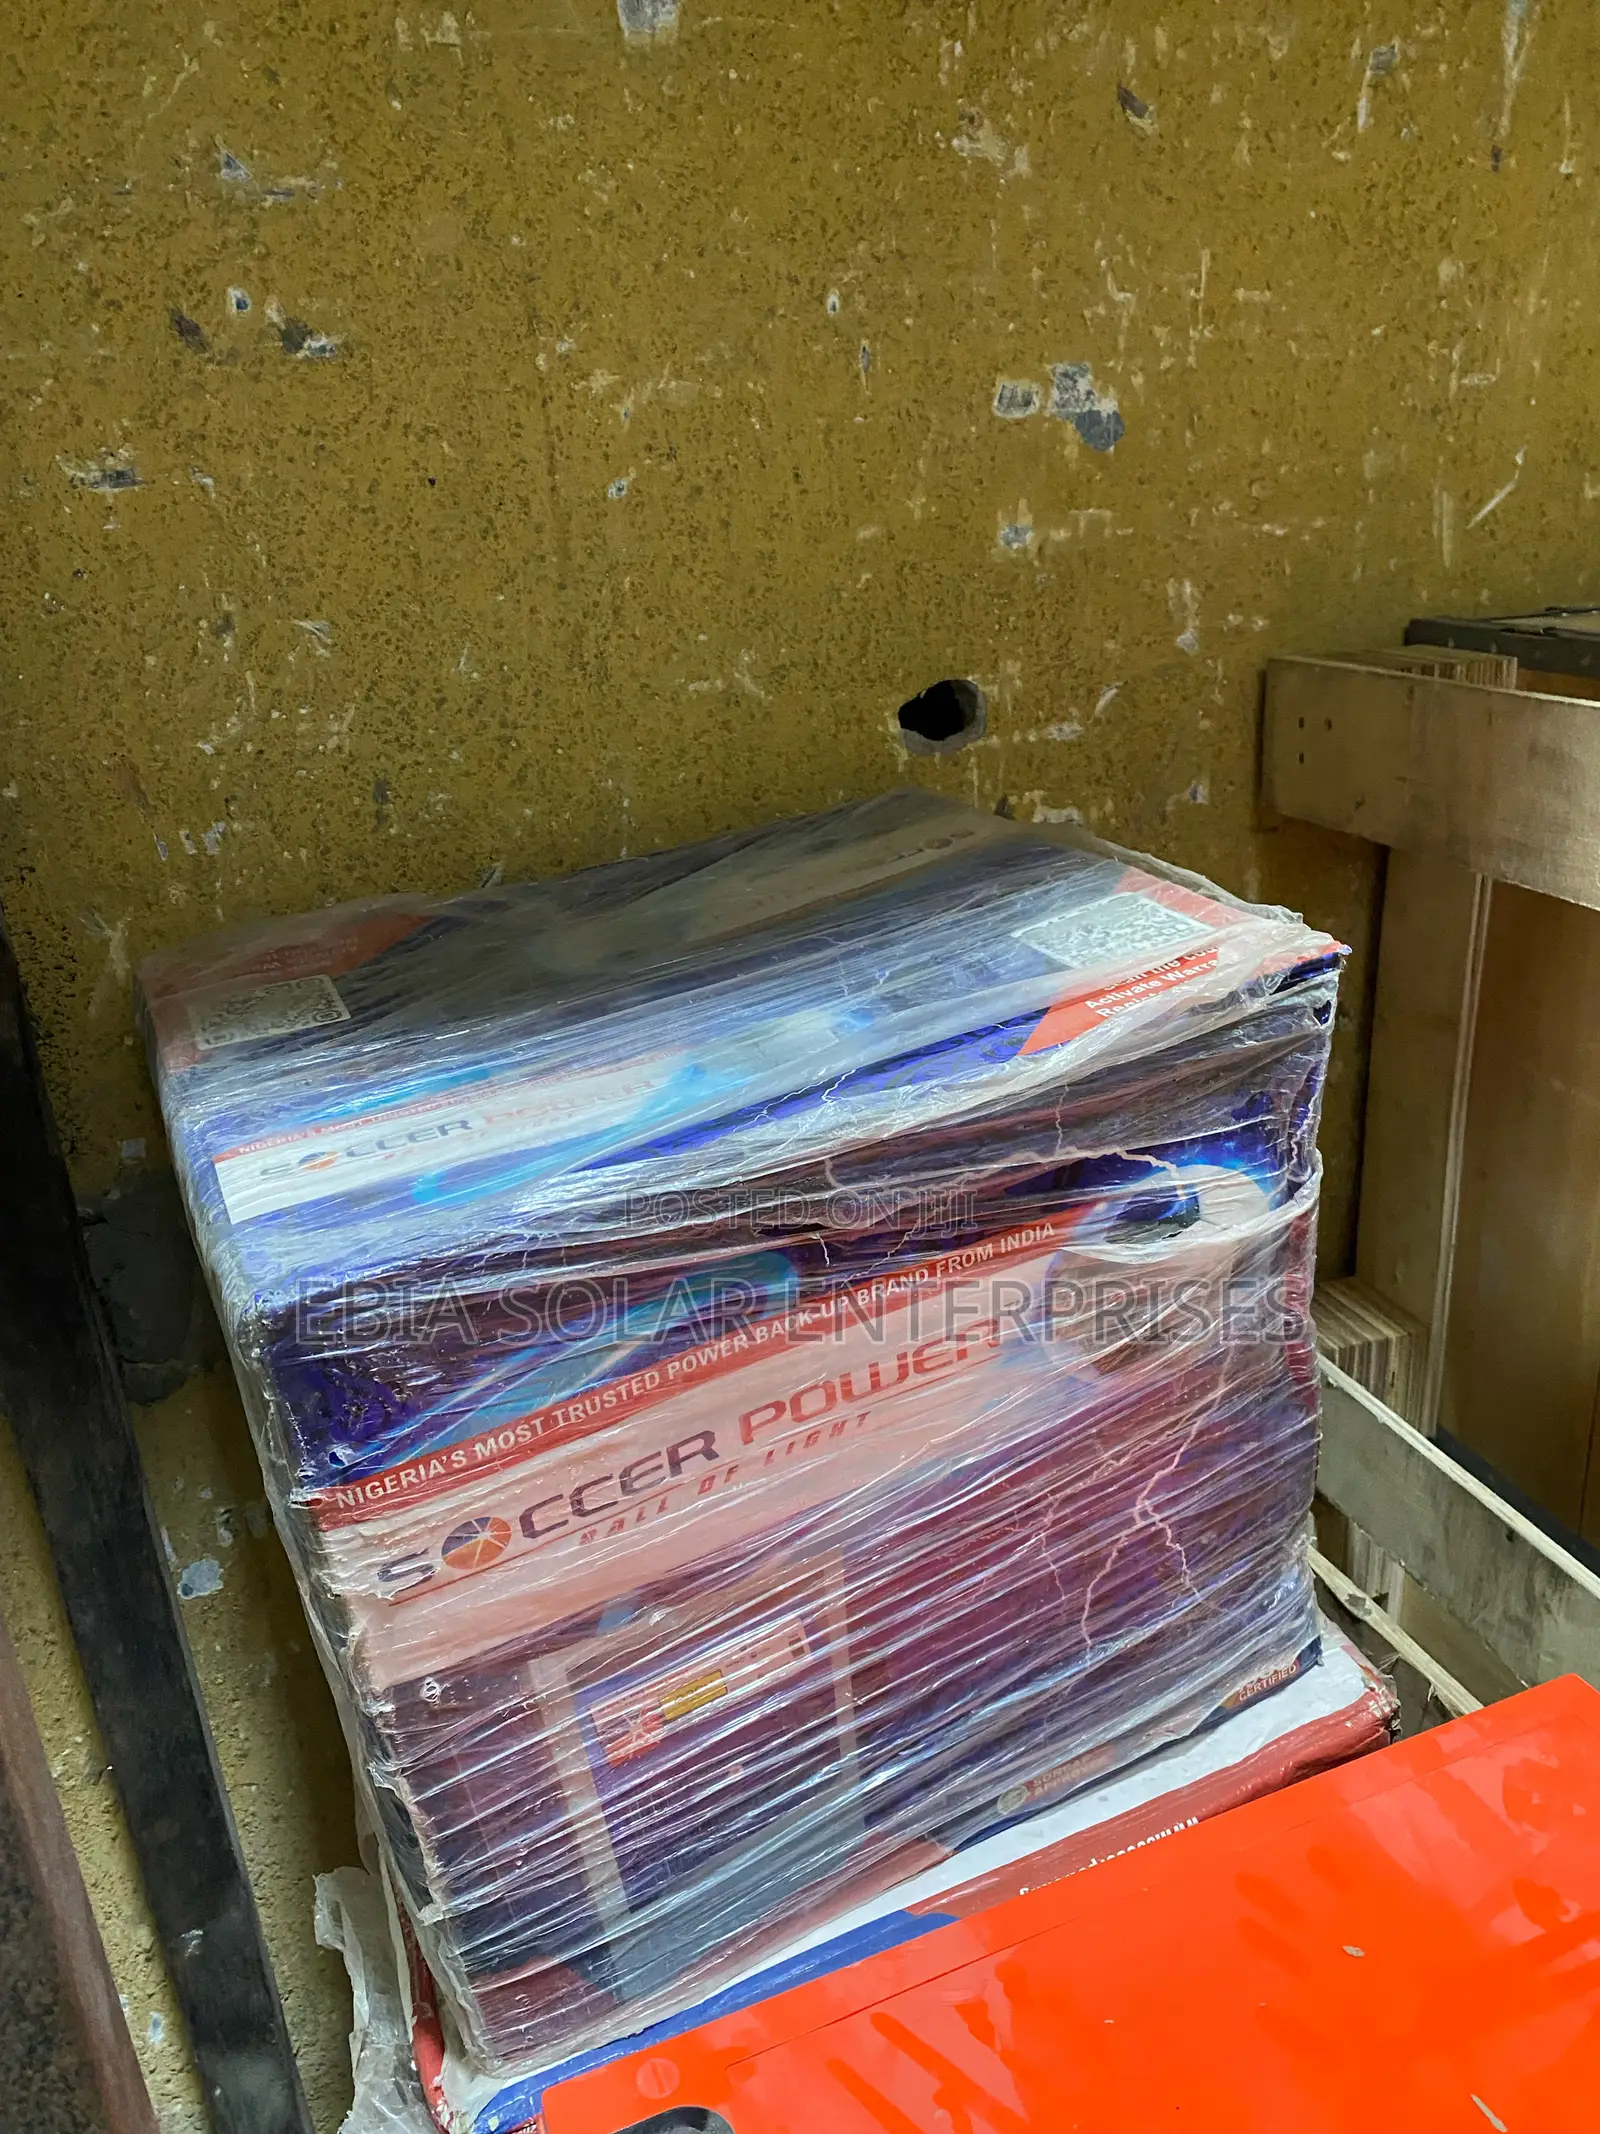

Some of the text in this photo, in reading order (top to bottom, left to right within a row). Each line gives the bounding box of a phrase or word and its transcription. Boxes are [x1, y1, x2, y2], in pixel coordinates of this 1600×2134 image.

[1085, 958, 1218, 1009] Activate Warra
[335, 1221, 1056, 1510] NIGERIA'S MOST TRUSTED POWER BACK-UP BRAND FROM INDIA
[738, 1317, 1001, 1446] POWER
[698, 1464, 740, 1496] OF
[763, 1410, 871, 1467] LIGHT
[1239, 1663, 1297, 1701] CERTIFIED
